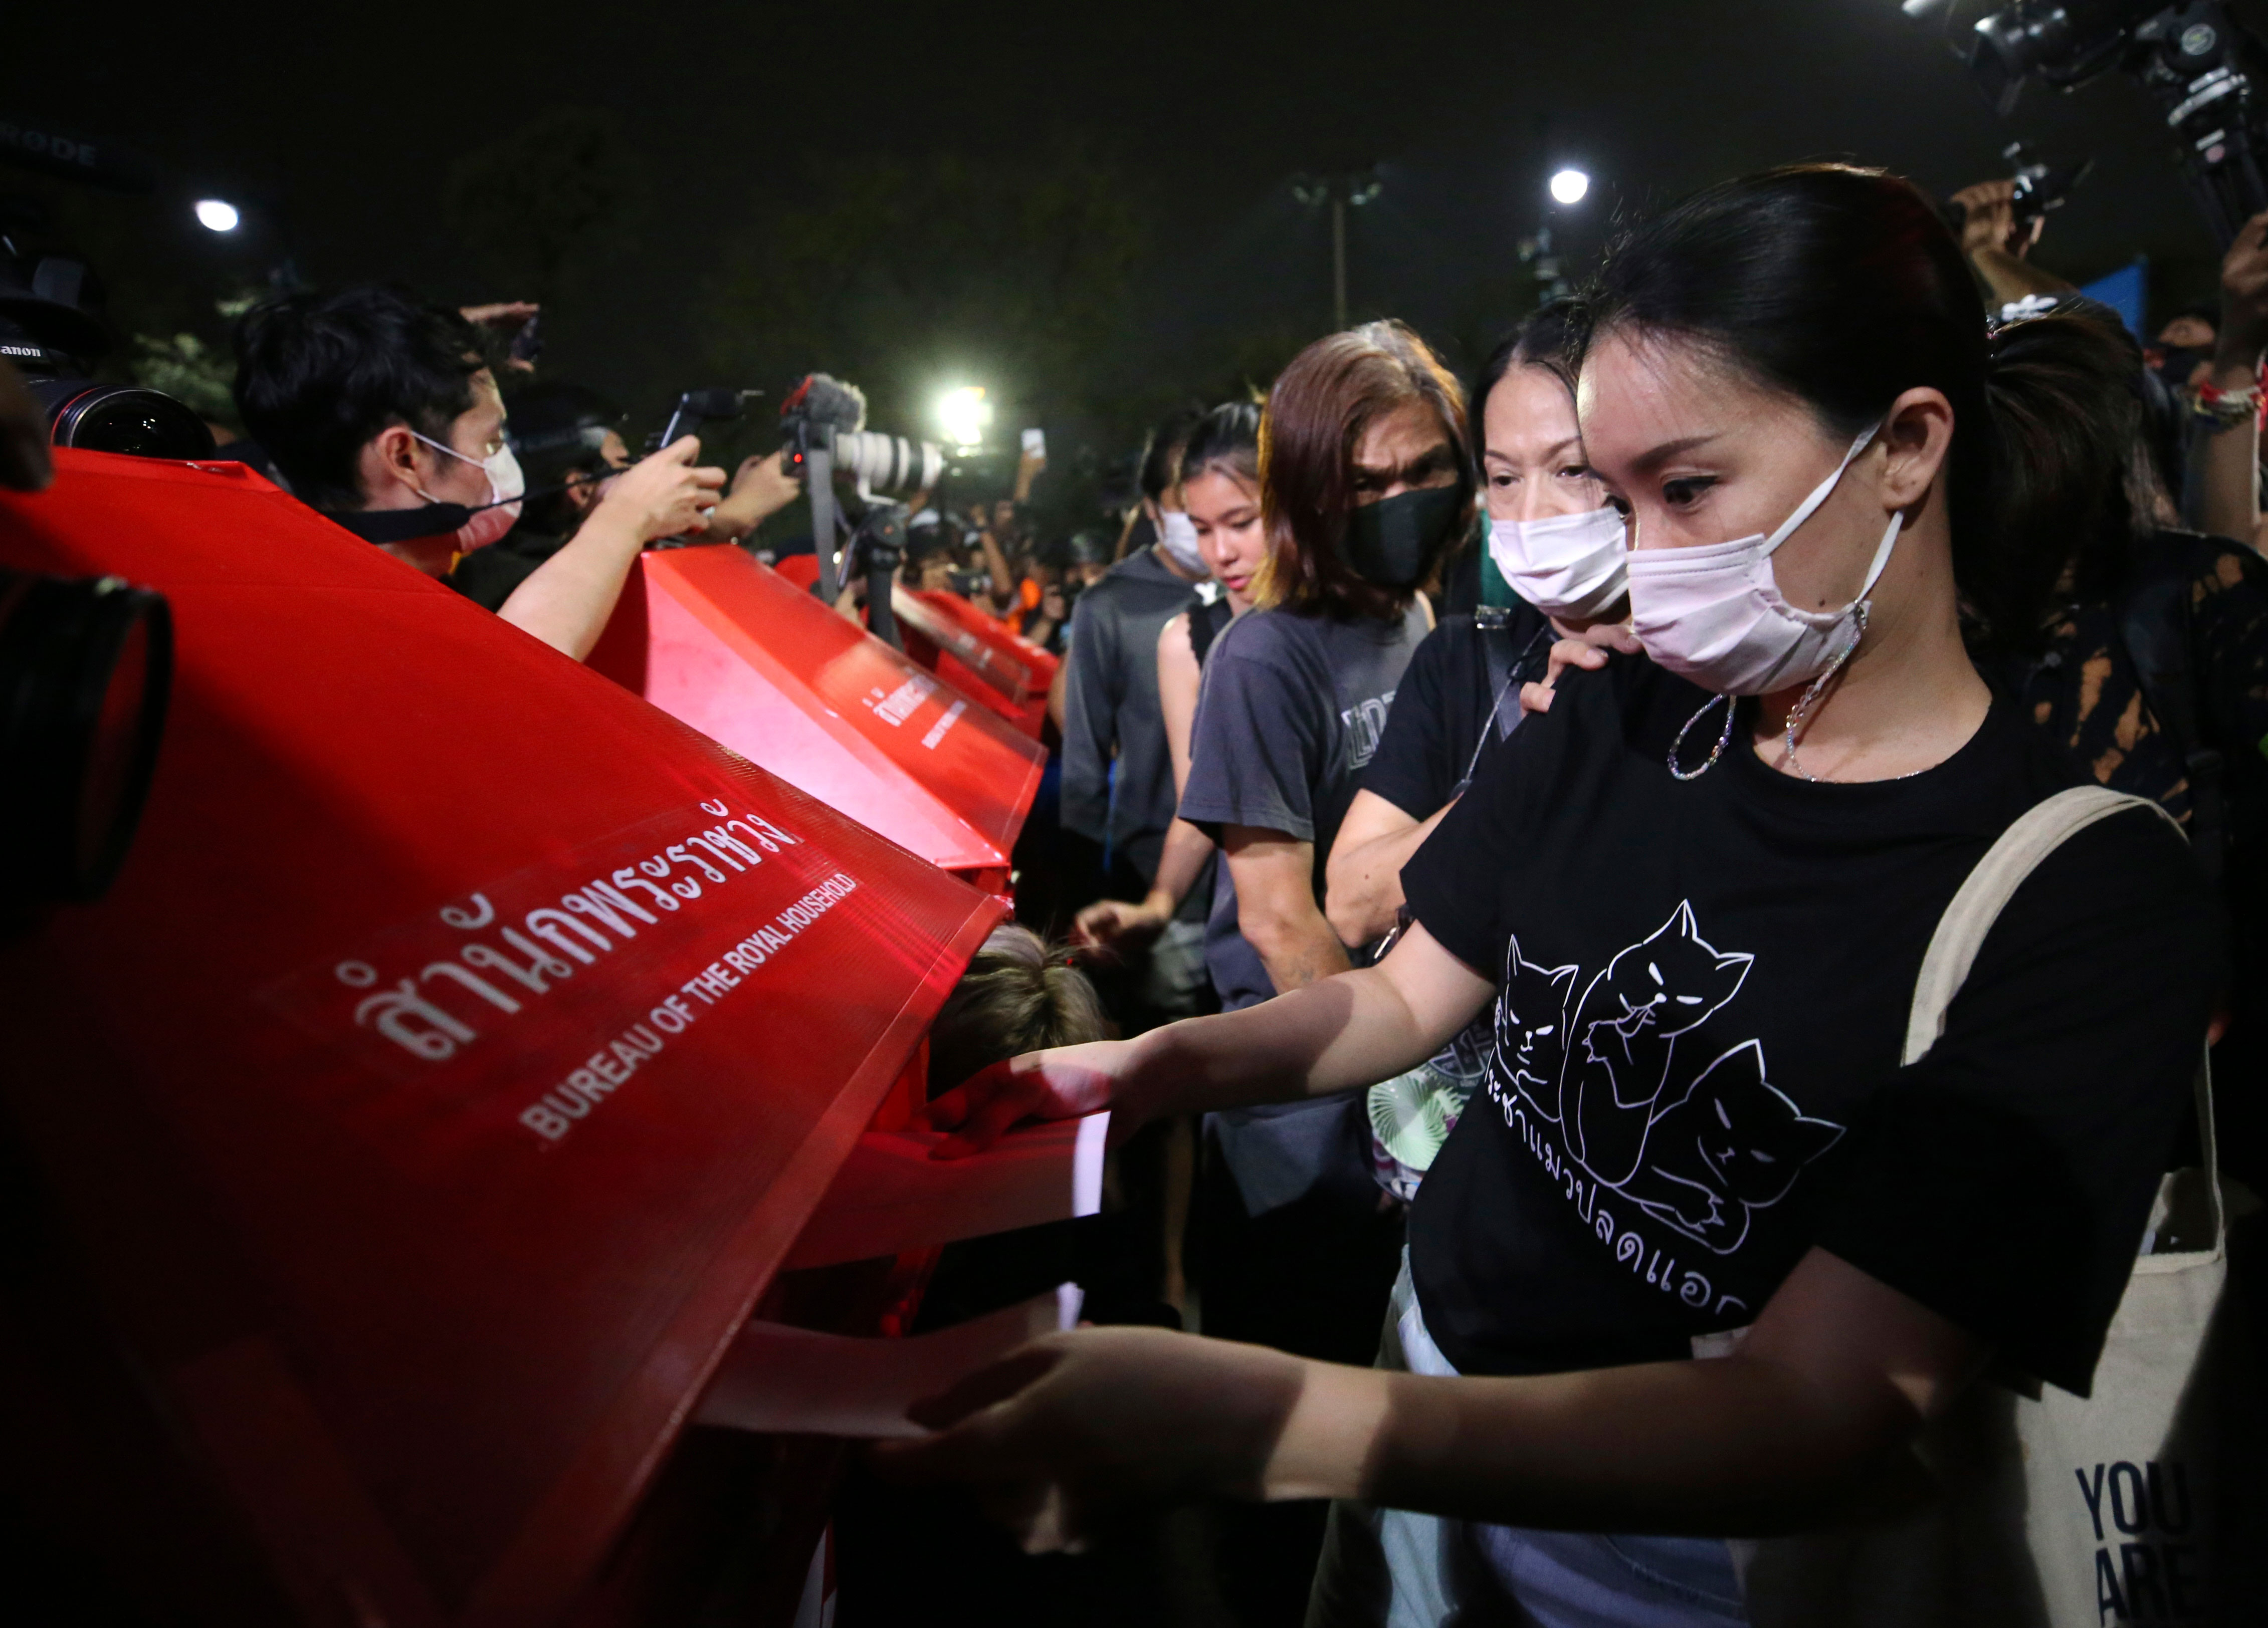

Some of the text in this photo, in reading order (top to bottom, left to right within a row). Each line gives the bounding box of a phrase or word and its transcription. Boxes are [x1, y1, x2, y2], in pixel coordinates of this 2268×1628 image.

[0, 346, 41, 357] anon
[333, 799, 796, 1061] สำนักพระราชวัง
[519, 873, 857, 1140] BUREAU OF THE ROYAL HOUSEHOLD
[2075, 1461, 2191, 1540] YOU
[2096, 1544, 2204, 1627] ARE
